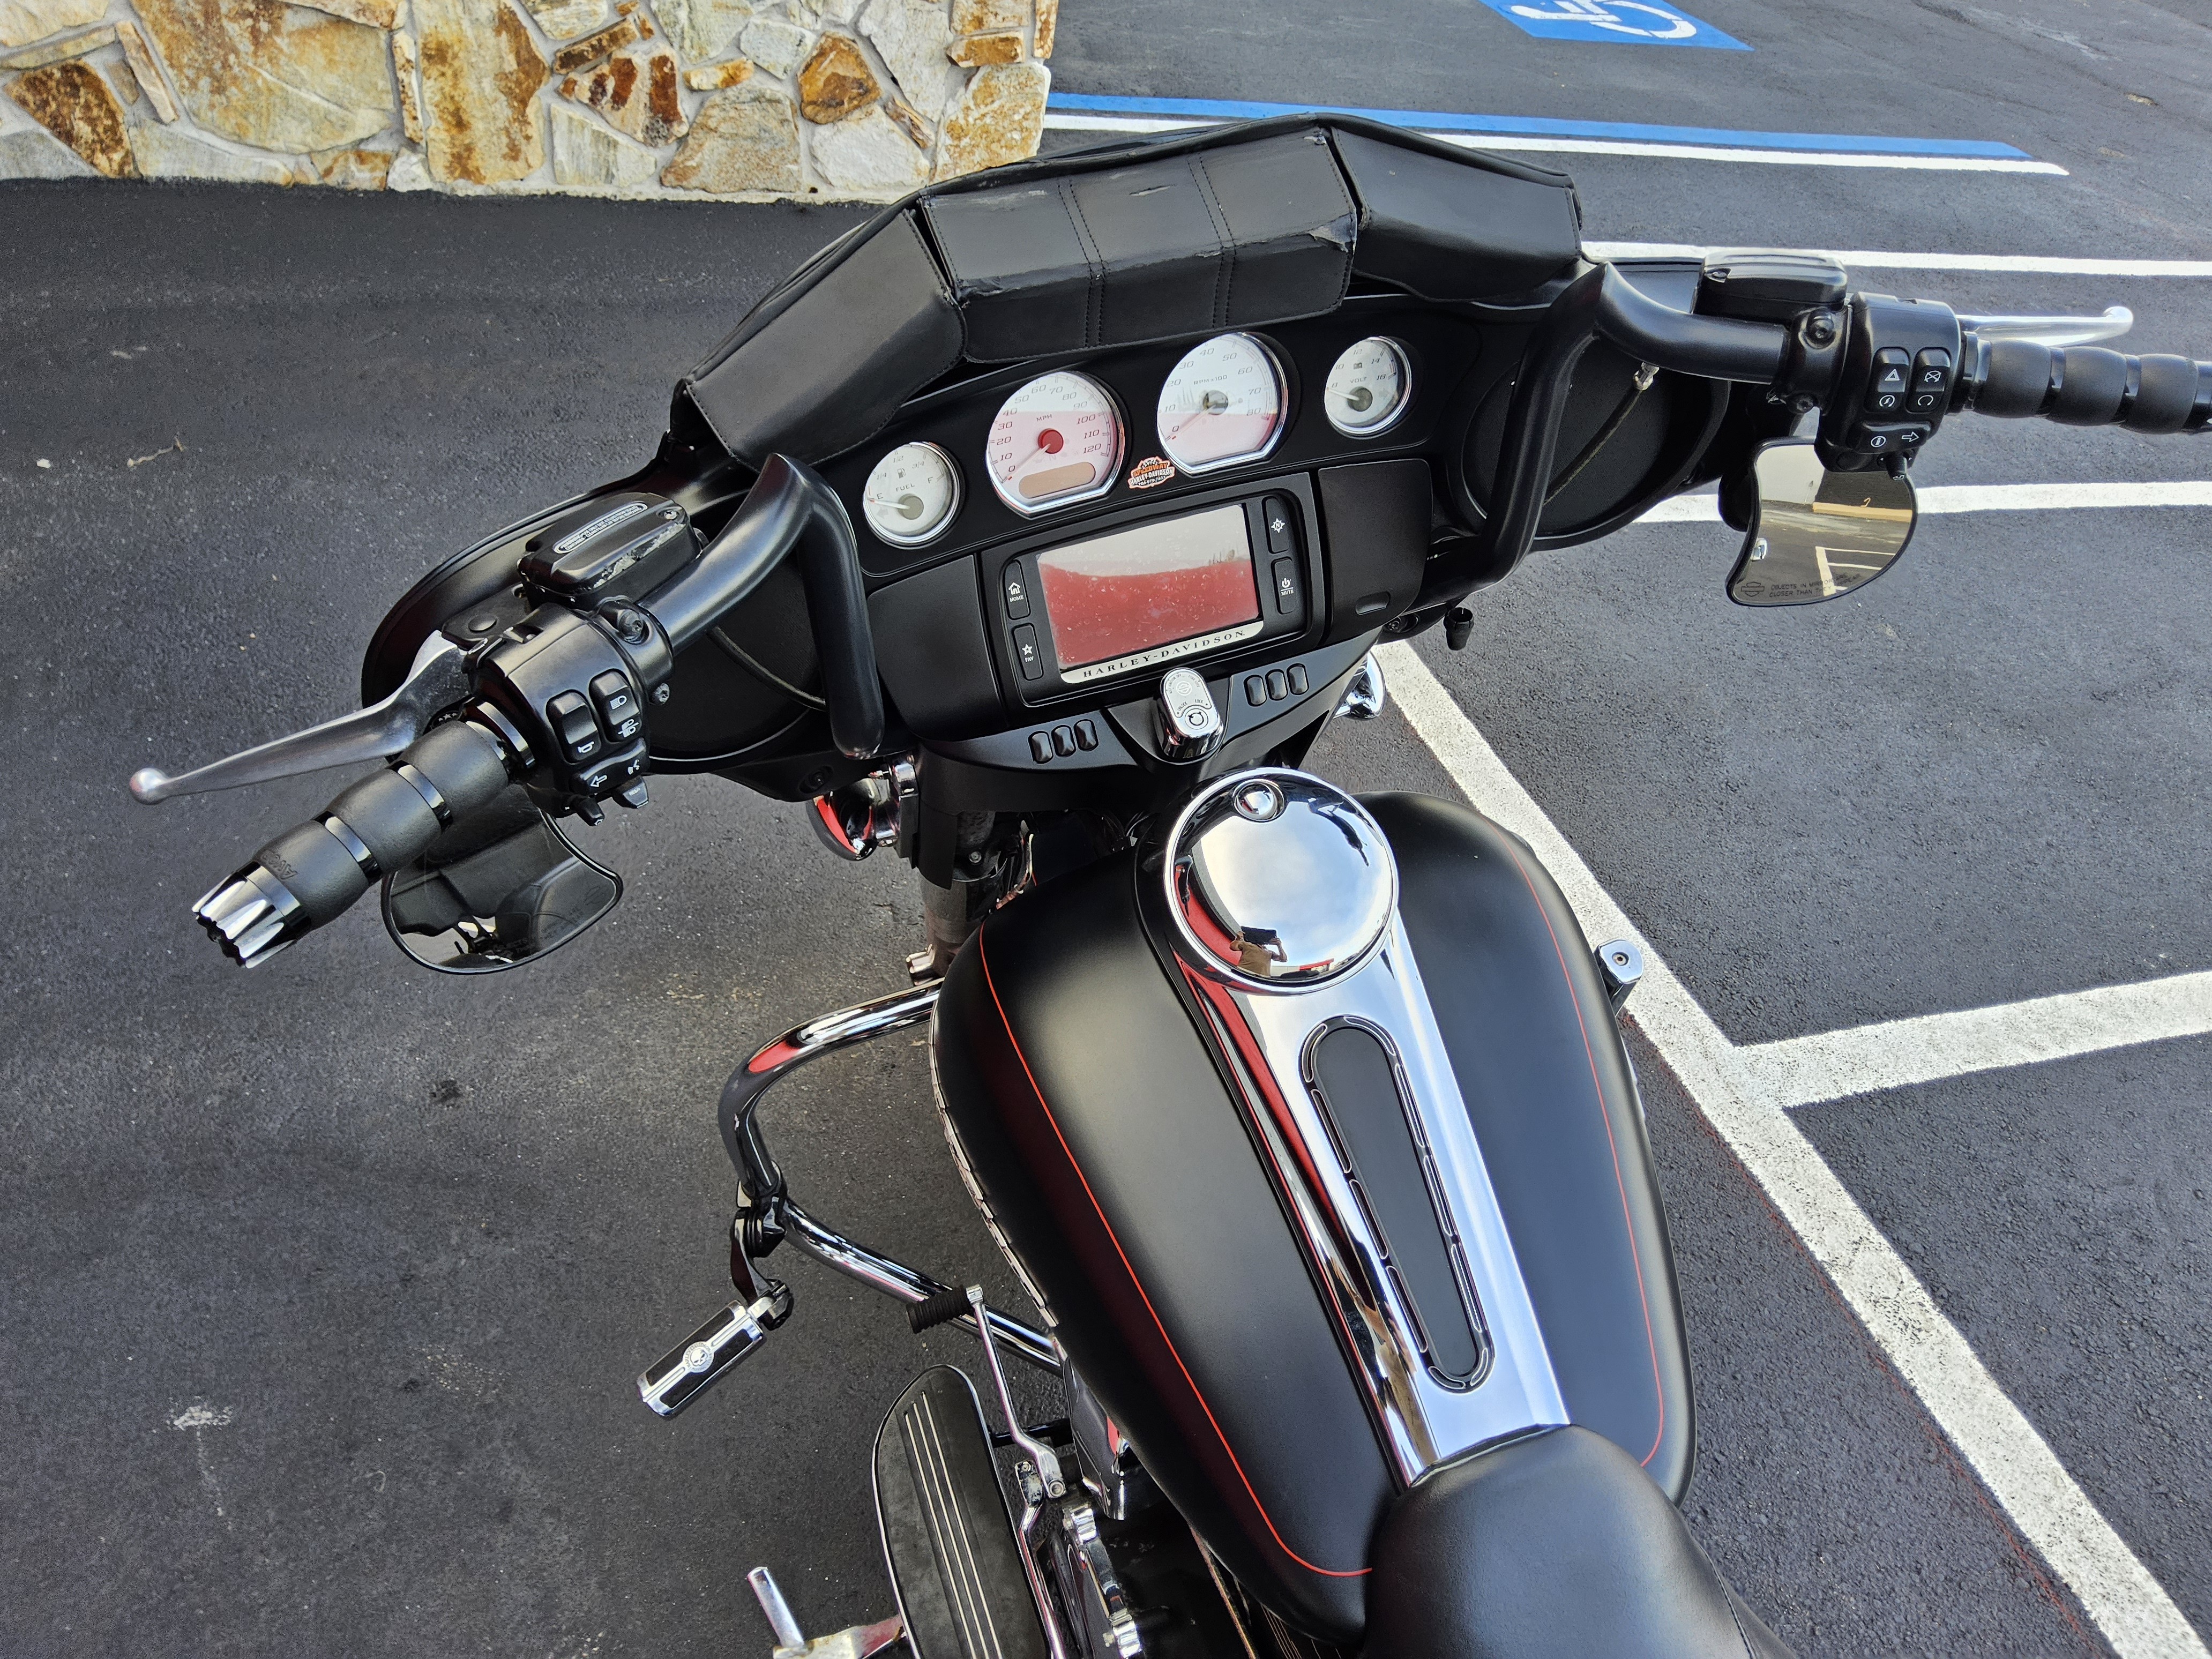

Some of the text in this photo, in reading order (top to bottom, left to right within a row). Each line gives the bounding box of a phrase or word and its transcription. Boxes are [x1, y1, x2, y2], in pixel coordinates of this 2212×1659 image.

[1200, 348, 1214, 356] 40
[1222, 353, 1237, 362] 50
[1179, 361, 1194, 369] 30
[1238, 367, 1253, 375] 60
[1166, 379, 1182, 387] 20
[1032, 385, 1046, 394] 60
[1049, 386, 1063, 394] 70
[1014, 395, 1029, 404] 50
[1062, 392, 1077, 401] 80
[1073, 401, 1087, 410] 90
[1164, 404, 1176, 413] 10
[1003, 408, 1018, 416] 40
[1246, 407, 1261, 416] 80
[1076, 414, 1096, 424] 100
[998, 421, 1013, 430] 30
[1083, 429, 1100, 439] 110
[997, 436, 1012, 445] 20
[1082, 444, 1102, 454] 120
[1000, 453, 1012, 461] 10
[1133, 463, 1168, 477] SPEEDWAY
[1130, 468, 1173, 486] HARLEY-DAVIDSON
[896, 483, 915, 491] FUEL
[1177, 701, 1188, 711] UNLOCK
